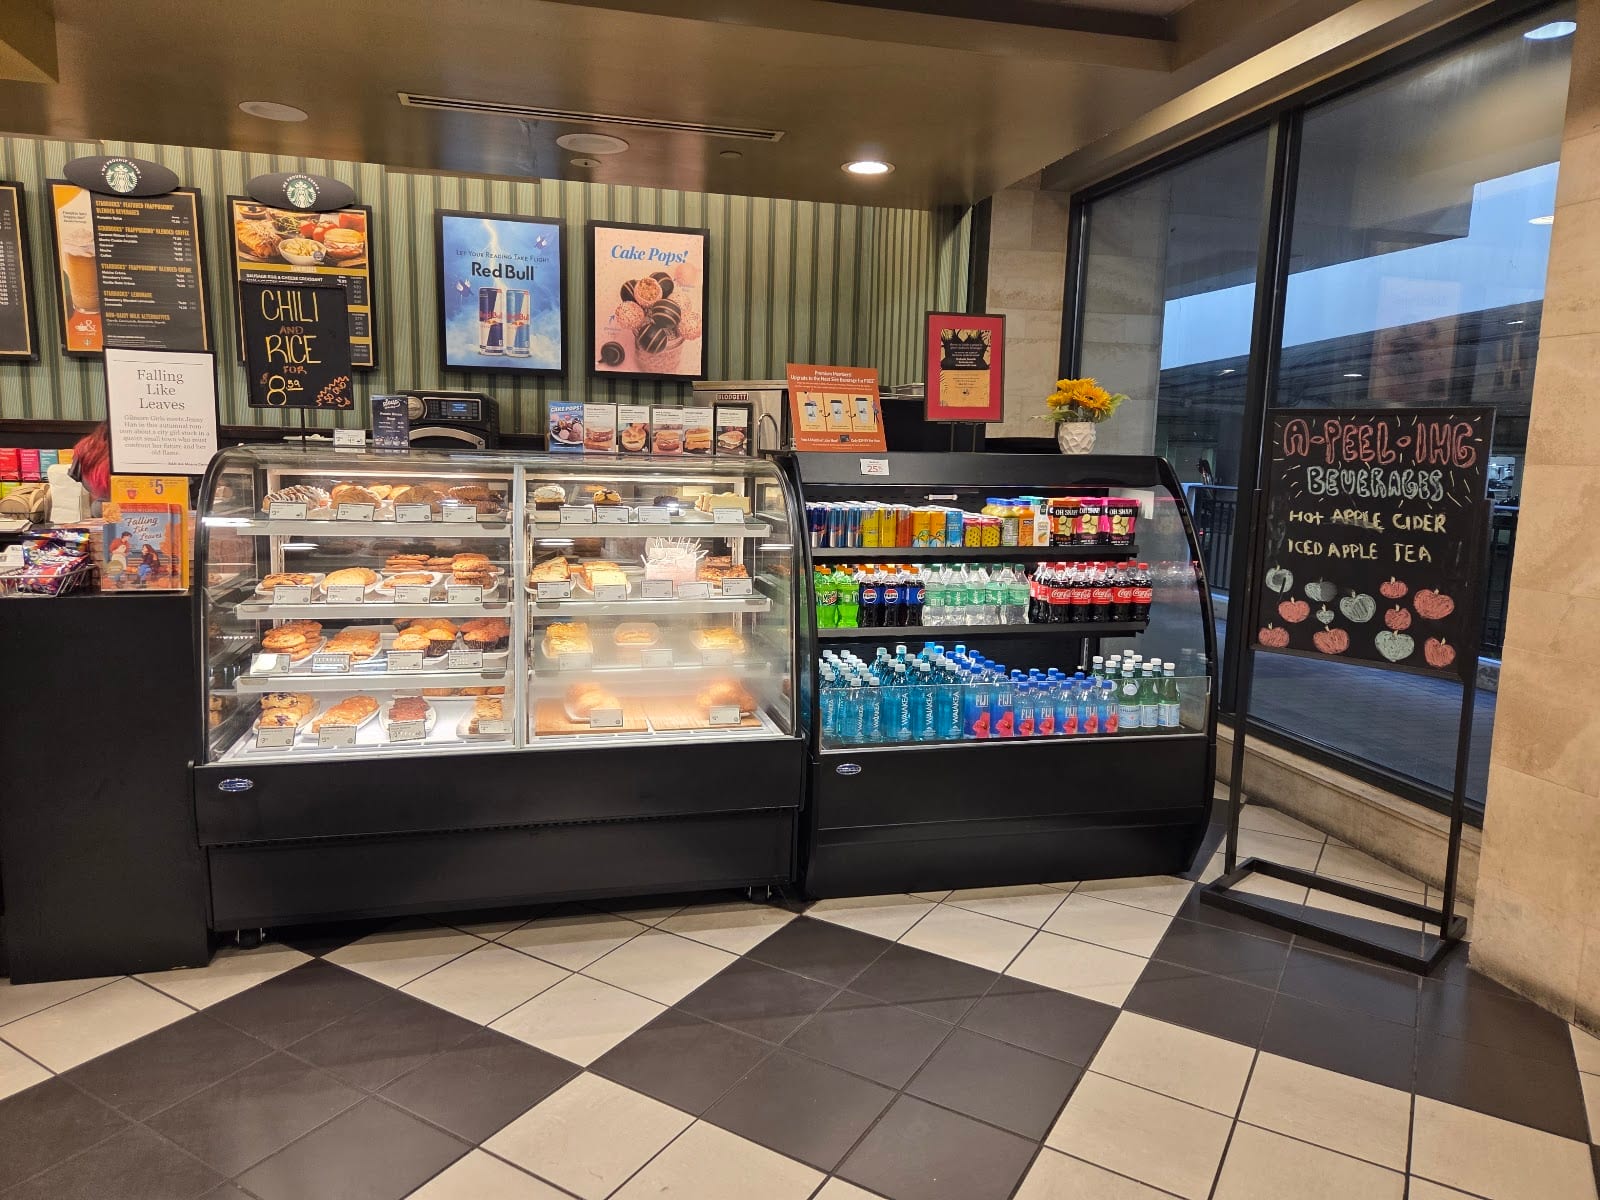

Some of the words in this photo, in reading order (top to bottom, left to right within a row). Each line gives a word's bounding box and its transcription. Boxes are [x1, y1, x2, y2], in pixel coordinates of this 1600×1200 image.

[611, 244, 646, 260] Cake
[648, 247, 689, 266] Pops!
[262, 289, 319, 322] CHILI
[280, 326, 304, 335] AND
[265, 335, 322, 364] RICE
[283, 365, 307, 375] FOR
[137, 369, 184, 384] Falling
[147, 383, 176, 396] Like
[139, 398, 185, 410] Leaves
[157, 429, 168, 437] city
[1307, 466, 1444, 501] BEVERAGES
[125, 517, 158, 526] Falling
[1332, 508, 1384, 532] APPLE
[1392, 512, 1447, 533] CIDER
[1288, 539, 1323, 556] ICED
[1328, 542, 1378, 560] APPLE
[1393, 543, 1432, 563] TEA
[976, 695, 989, 706] FIJI
[998, 693, 1012, 706] FIJI
[925, 692, 933, 725] WAIAKEA
[952, 691, 960, 723] WAIAKEA
[1041, 706, 1054, 718] FIJI
[1065, 706, 1078, 718] FIJI
[1086, 705, 1098, 716] FIJI
[1106, 704, 1118, 715] FIJI
[1021, 708, 1034, 719] FIJI
